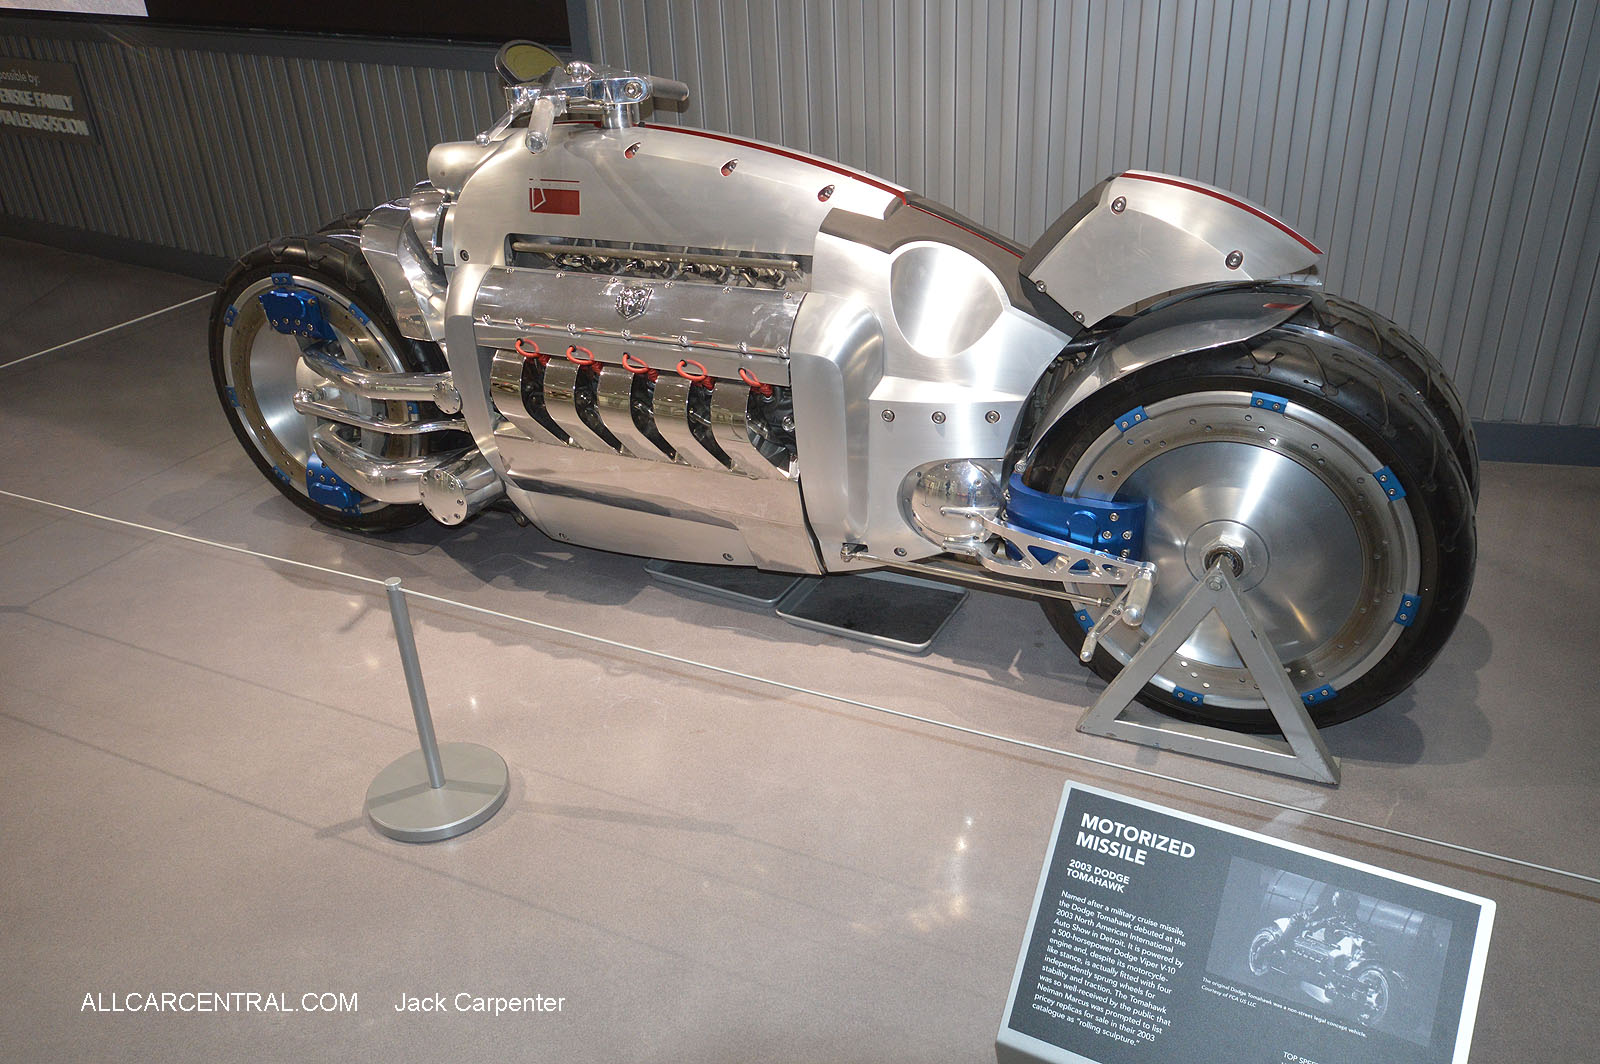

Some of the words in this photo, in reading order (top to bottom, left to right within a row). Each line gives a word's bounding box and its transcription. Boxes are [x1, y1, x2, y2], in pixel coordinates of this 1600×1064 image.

[33, 92, 74, 111] FAMILY
[1075, 831, 1148, 866] MISSILE
[1080, 812, 1196, 858] MOTORIZED
[1066, 867, 1125, 894] TOMAHAWK
[1069, 859, 1092, 873] 2003
[1093, 866, 1130, 885] DODGE
[1056, 908, 1074, 920] 2003
[1074, 914, 1095, 927] North
[1095, 921, 1129, 938] American
[1129, 932, 1174, 953] International
[1058, 899, 1071, 909] the
[1071, 903, 1095, 917] Dodge
[1096, 911, 1132, 929] Tomahawk
[1133, 924, 1165, 940] debuted
[1164, 935, 1173, 943] at
[1174, 937, 1187, 947] the
[1061, 890, 1087, 904] Named
[1086, 899, 1104, 909] after
[1110, 907, 1137, 922] military
[1137, 916, 1159, 928] cruise
[1159, 923, 1185, 937] missile,
[1049, 937, 1073, 950] engine
[1073, 945, 1088, 956] and,
[1089, 950, 1116, 965] despite
[1116, 958, 1126, 968] its
[1126, 964, 1169, 982] motorcycle-
[1053, 917, 1071, 929] Auto
[1071, 923, 1091, 936] Show
[1091, 930, 1099, 938] in
[1099, 932, 1126, 948] Detroit.
[1127, 942, 1134, 950] It
[1134, 944, 1141, 953] is
[1141, 948, 1175, 964] powered
[1174, 957, 1184, 969] by
[1057, 928, 1113, 953] 500-horsepower
[1113, 947, 1139, 962] Dodge
[1139, 956, 1159, 969] Viper
[1160, 963, 1176, 975] V-10
[1042, 965, 1069, 980] stability
[1069, 975, 1084, 984] and
[1084, 979, 1112, 995] traction.
[1114, 988, 1128, 1000] The
[1129, 994, 1167, 1015] Tomahawk
[1044, 954, 1093, 979] independently
[1093, 973, 1118, 988] sprung
[1119, 982, 1144, 996] wheels
[1145, 989, 1156, 999] for
[1046, 945, 1059, 955] like
[1059, 951, 1083, 965] stance,
[1084, 958, 1091, 966] is
[1091, 962, 1119, 977] actually
[1119, 970, 1140, 983] fitted
[1140, 979, 1156, 989] with
[1156, 983, 1173, 995] four
[1032, 1003, 1066, 1020] catalogue
[1066, 1015, 1075, 1023] as
[1034, 993, 1056, 1007] pricey
[1056, 1001, 1082, 1015] replicas
[1083, 1009, 1094, 1019] for
[1094, 1015, 1110, 1025] sale
[1110, 1019, 1118, 1028] in
[1119, 1023, 1136, 1035] their
[1136, 1029, 1156, 1042] 2003
[1037, 982, 1064, 998] Neiman
[1064, 992, 1090, 1008] Marcus
[1090, 1003, 1104, 1013] was
[1104, 1009, 1142, 1026] prompted
[1142, 1021, 1151, 1030] to
[1151, 1023, 1163, 1034] list
[1039, 974, 1053, 984] was
[1053, 979, 1062, 987] so
[1063, 983, 1109, 1004] well-received
[1109, 997, 1119, 1009] by
[1119, 1002, 1132, 1012] the
[1132, 1008, 1155, 1021] public
[1156, 1015, 1171, 1027] that
[1201, 984, 1222, 996] Courtesy
[1228, 994, 1239, 1002] FCA
[1247, 1000, 1257, 1008] LLC
[1202, 976, 1212, 984] The
[1211, 981, 1230, 990] original
[1230, 986, 1247, 996] Dodge
[1247, 992, 1272, 1005] Tomahawk
[1287, 1007, 1313, 1019] non-street
[1313, 1015, 1327, 1024] legal
[1326, 1021, 1348, 1031] concept
[1283, 1051, 1298, 1061] TOP
